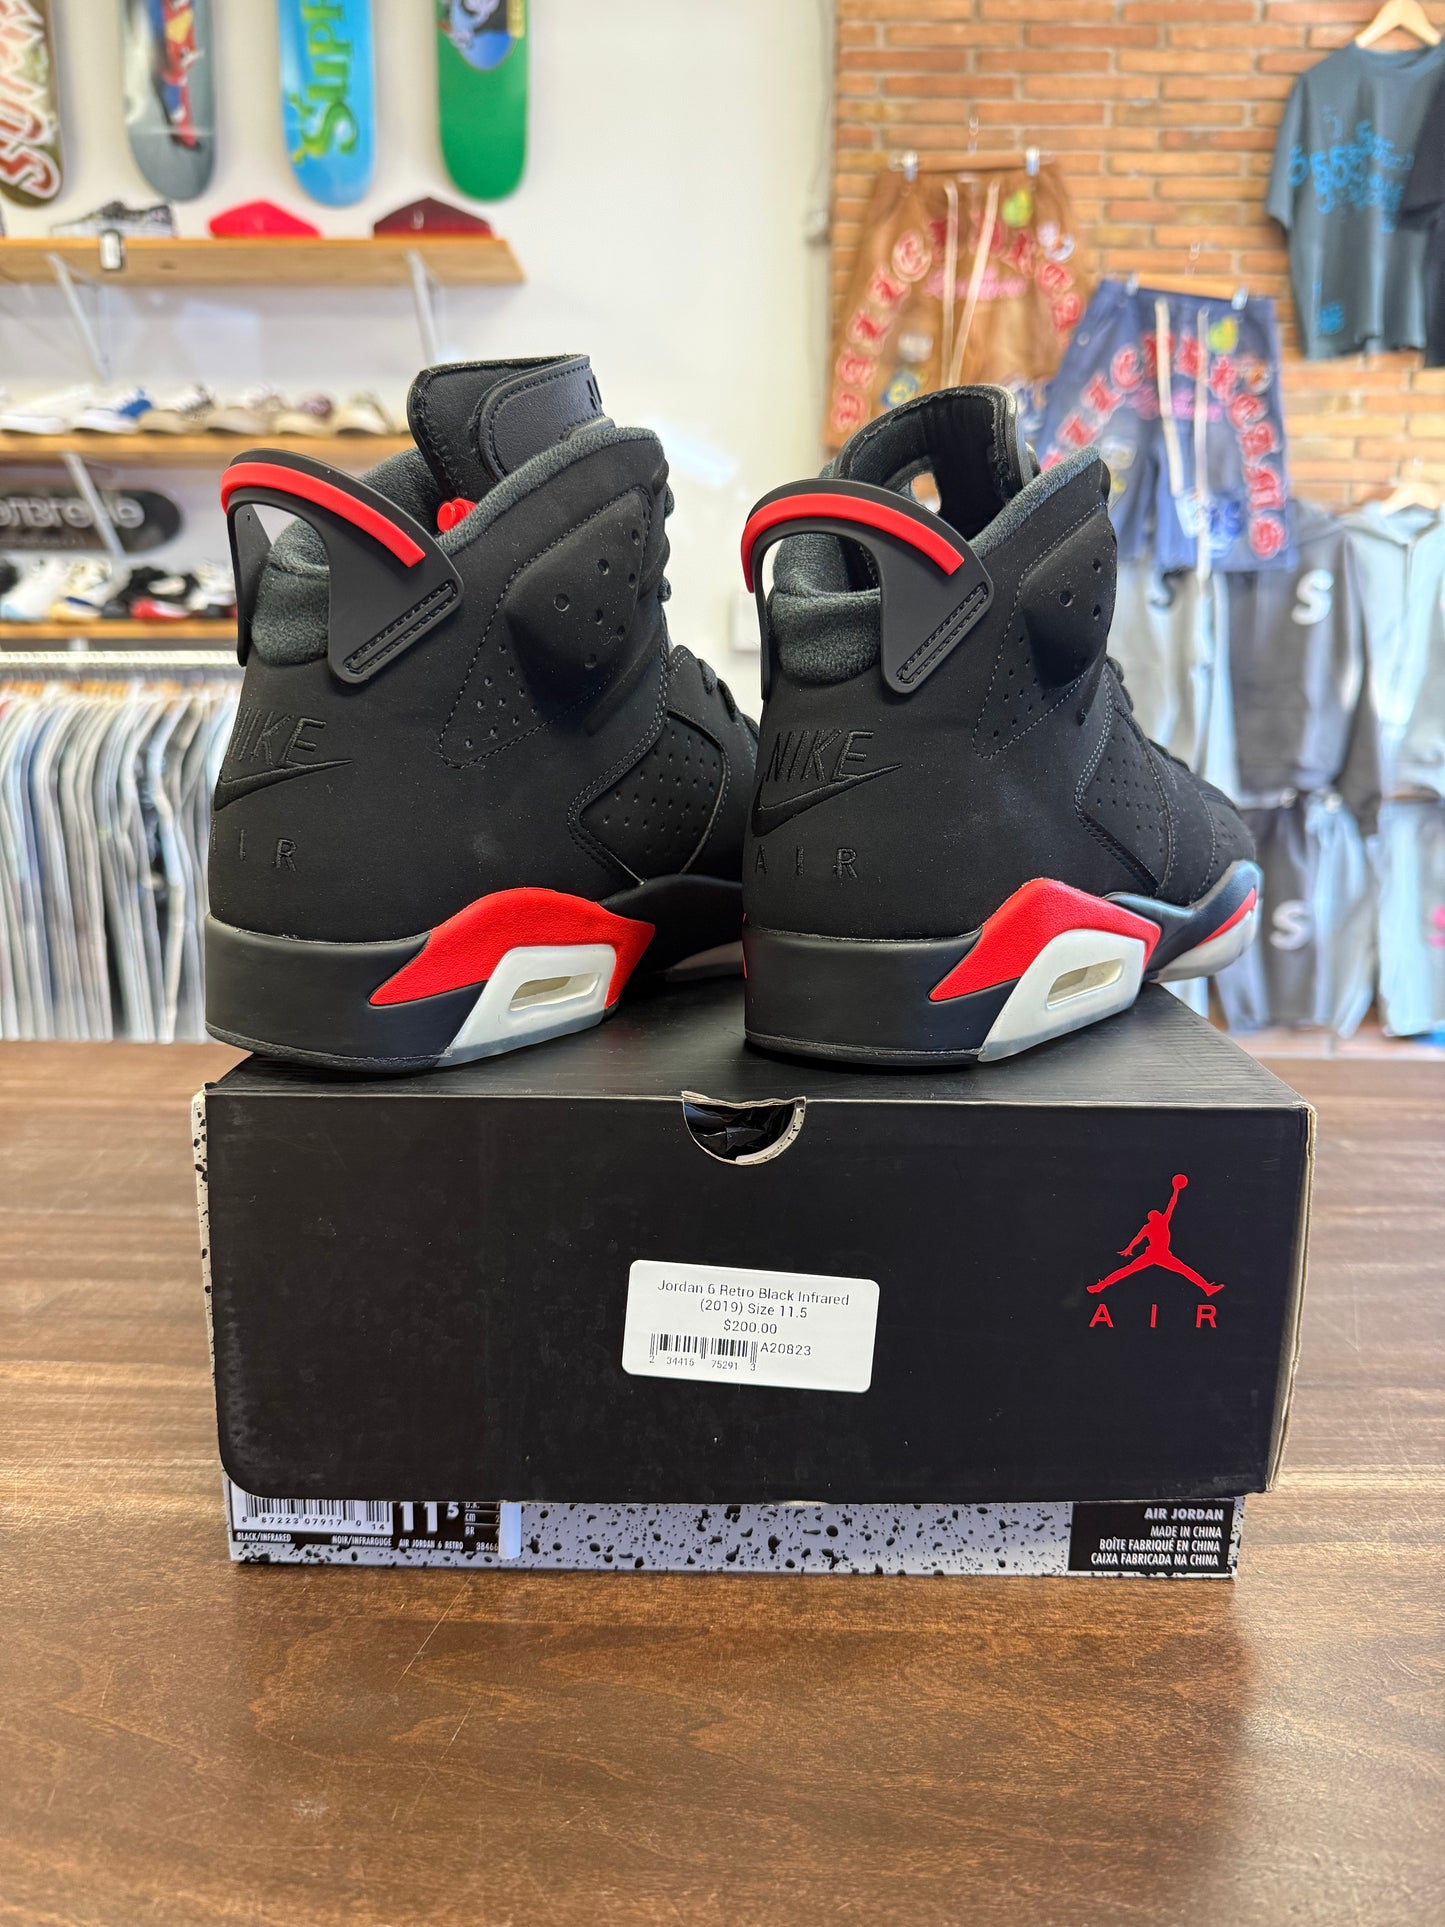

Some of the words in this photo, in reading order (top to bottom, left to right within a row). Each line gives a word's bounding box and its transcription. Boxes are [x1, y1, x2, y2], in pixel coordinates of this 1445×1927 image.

[765, 728, 875, 782] NIKE
[755, 844, 857, 879] AIR
[657, 1279, 703, 1294] Jordan
[707, 1283, 716, 1295] 6
[719, 1284, 755, 1298] Retro
[758, 1287, 794, 1302] Black
[798, 1290, 850, 1306] Infrared
[700, 1298, 744, 1316] (2019)
[747, 1302, 775, 1316] Size
[780, 1304, 808, 1319] 11.5
[1088, 1303, 1217, 1329] AIR
[723, 1318, 778, 1335] $200.00
[760, 1341, 812, 1356] A20823
[711, 1359, 739, 1371] 75291
[1144, 1507, 1168, 1520] AIR
[1170, 1508, 1224, 1520] JORDAN
[236, 1531, 292, 1543] BLACK/INFRARED
[1150, 1525, 1178, 1538] MADE
[1180, 1526, 1191, 1538] IN
[1192, 1526, 1223, 1539] CHINA
[331, 1535, 392, 1547] NOIR/INFRAROUGE
[398, 1539, 410, 1548] AIR
[411, 1539, 436, 1549] JORDAN
[444, 1541, 464, 1550] RETRO
[1099, 1536, 1127, 1552] BOÎTE
[1128, 1538, 1174, 1552] FABRIQUÉ
[1176, 1540, 1189, 1552] EN
[1191, 1540, 1220, 1553] CHINA
[1090, 1552, 1118, 1566] CAIXA
[1120, 1553, 1172, 1567] FABRICADA
[1174, 1554, 1187, 1567] NA
[1189, 1554, 1219, 1567] CHINA
